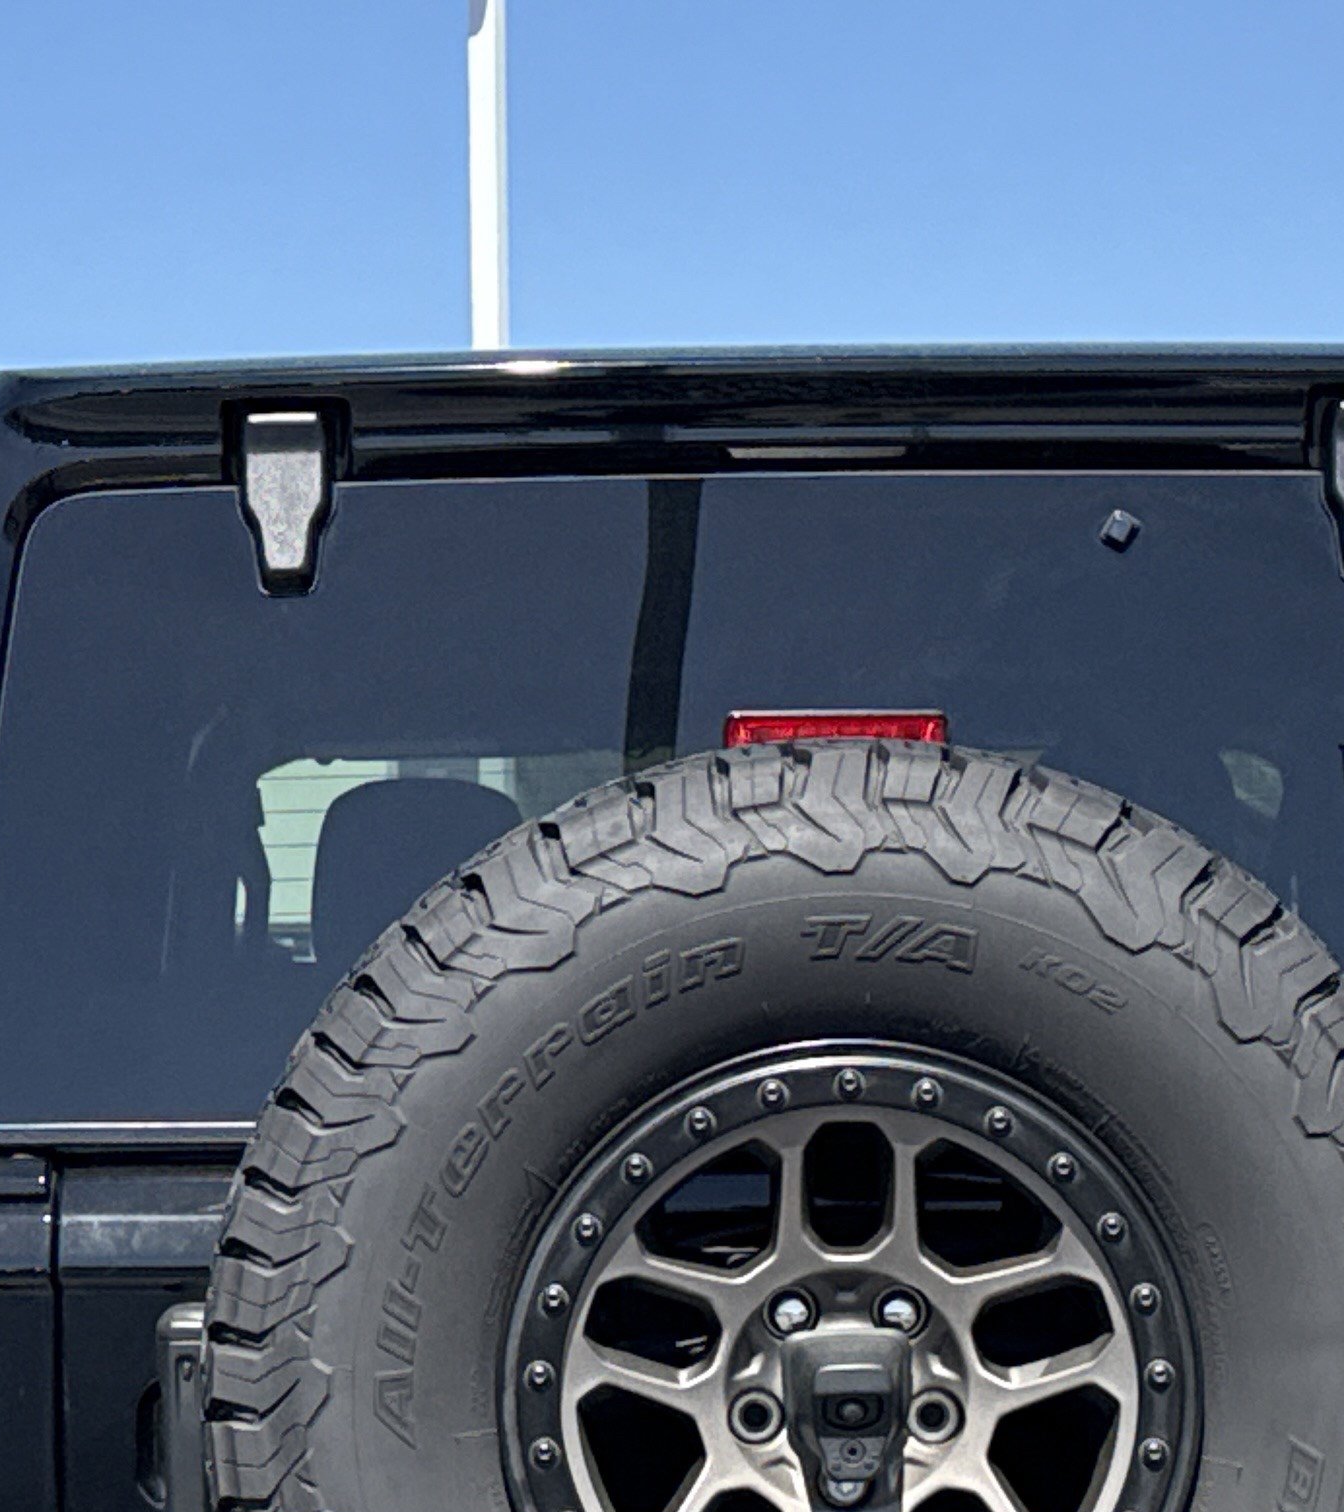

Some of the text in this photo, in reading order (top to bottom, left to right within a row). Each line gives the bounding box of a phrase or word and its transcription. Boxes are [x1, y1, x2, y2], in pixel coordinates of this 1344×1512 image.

[373, 937, 745, 1450] All-Terrain
[800, 914, 979, 972] T/A
[1017, 946, 1129, 1015] KO2
